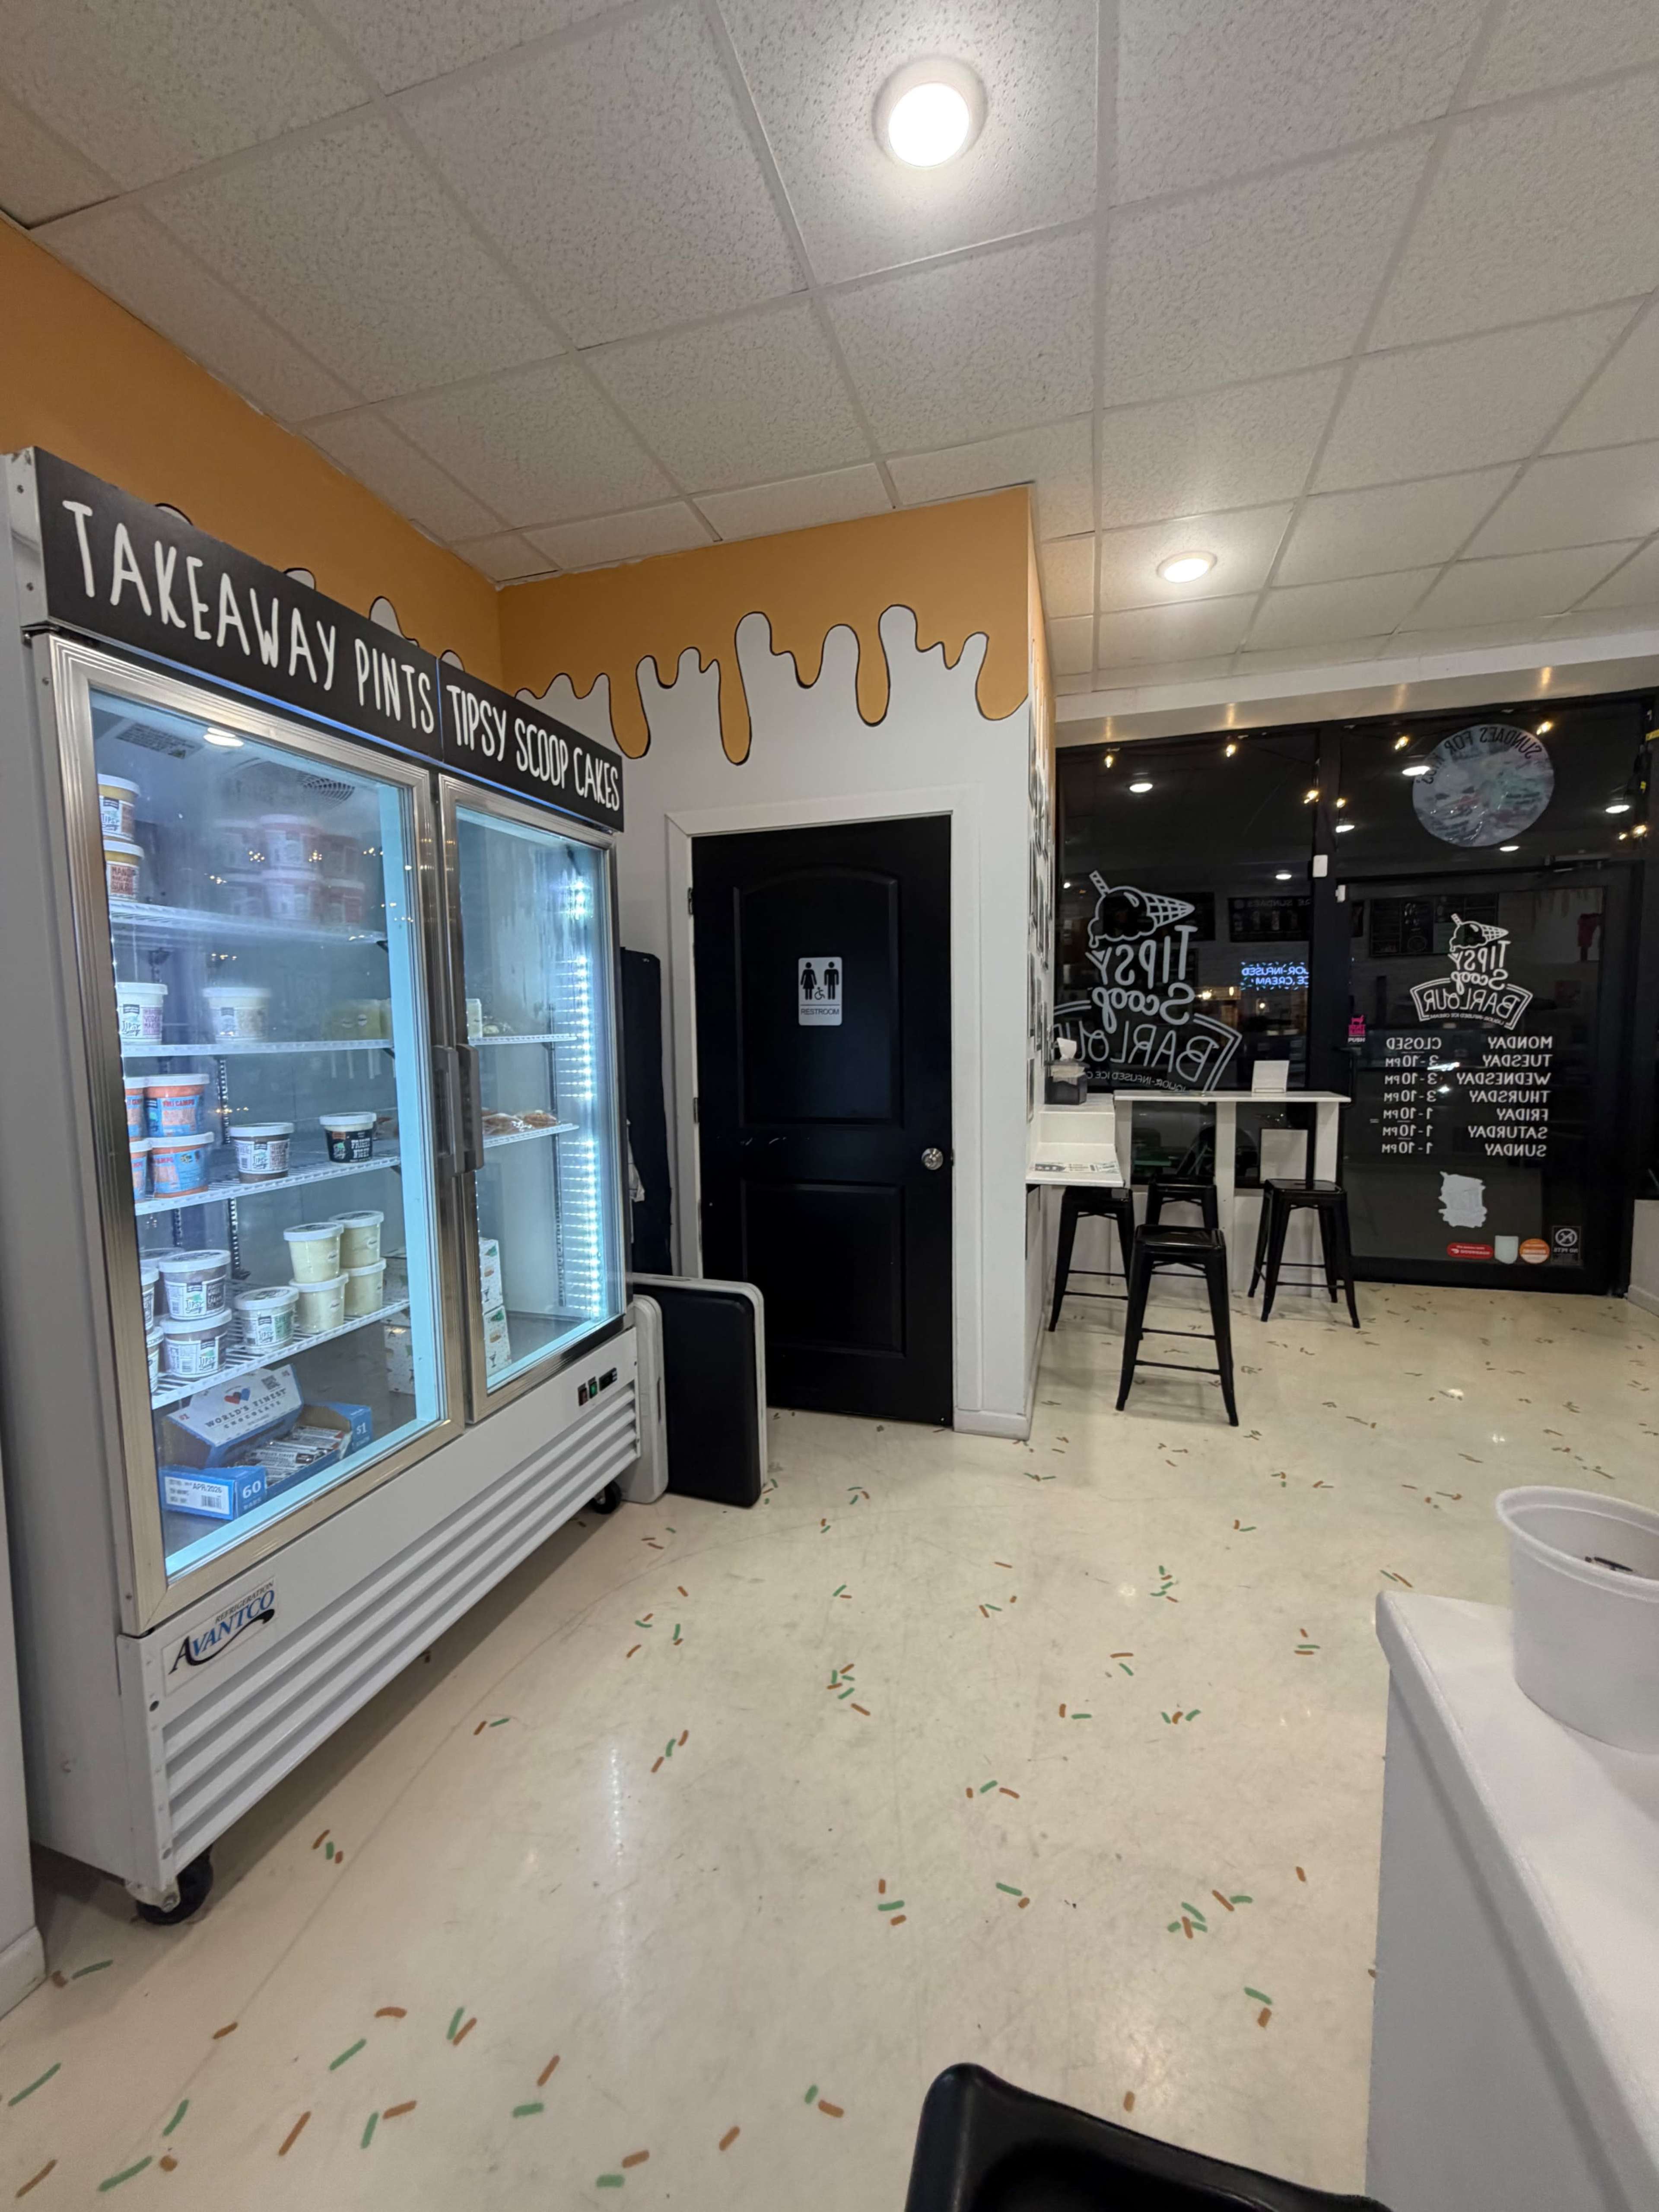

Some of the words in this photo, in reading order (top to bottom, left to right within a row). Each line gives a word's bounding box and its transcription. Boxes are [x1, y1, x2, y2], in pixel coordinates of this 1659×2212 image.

[62, 500, 336, 691] TAKEAWAY
[354, 638, 435, 734] PINTS
[446, 685, 506, 762] TIPSY
[515, 718, 569, 789] SCOOP
[573, 747, 620, 812] CAKES
[205, 1405, 249, 1428] WORLD'S
[252, 1388, 287, 1407] FINEST
[223, 1400, 281, 1429] CHOCOLATE
[242, 1480, 261, 1499] 60
[215, 1579, 274, 1623] REFRIGERATION
[168, 1590, 275, 1675] AVANTCO
